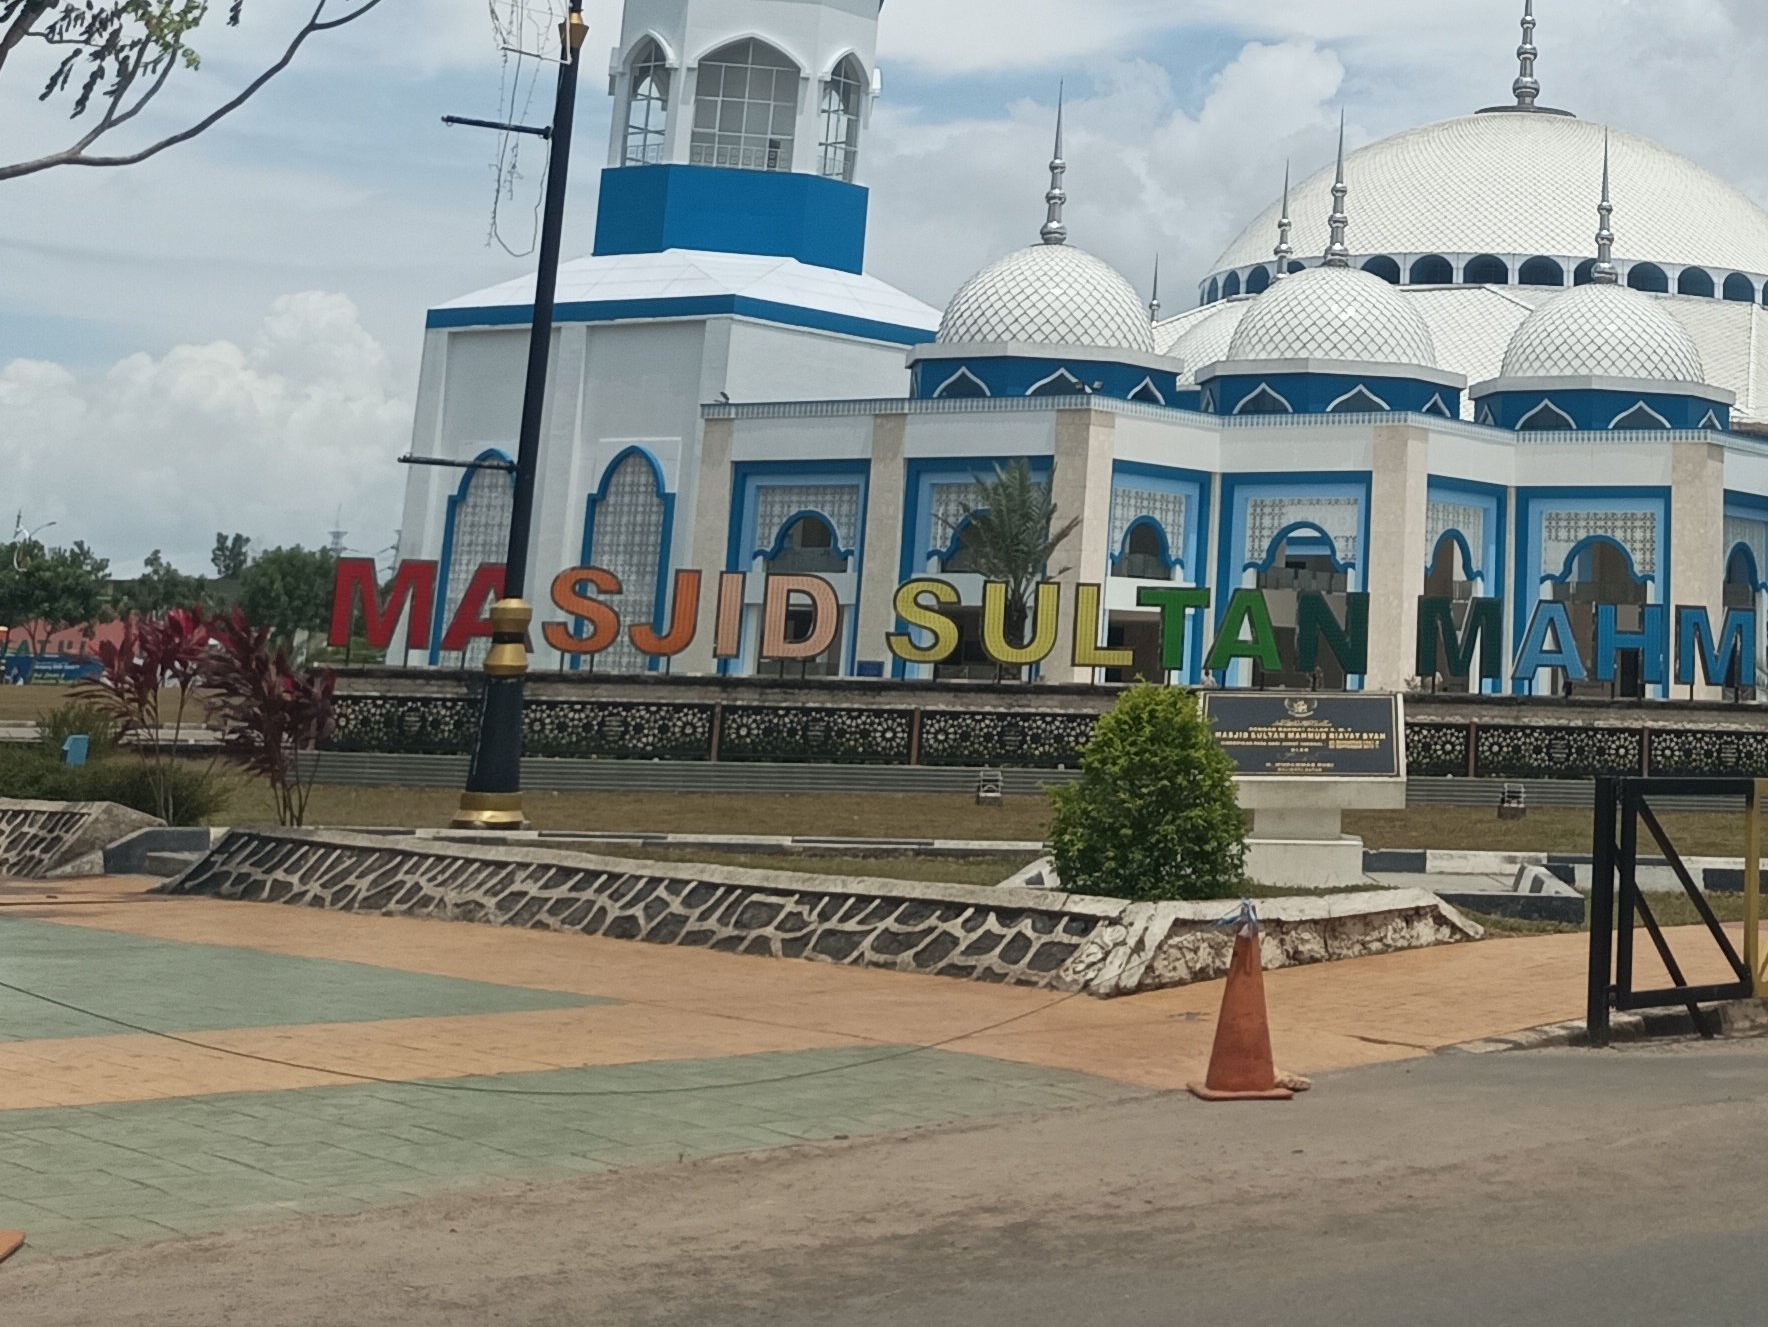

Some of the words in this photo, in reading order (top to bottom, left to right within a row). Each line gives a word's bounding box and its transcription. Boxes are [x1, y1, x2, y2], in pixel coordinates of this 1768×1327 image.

[327, 557, 840, 660] MASJID
[886, 578, 1370, 676] SULTAN
[1250, 731, 1286, 740] SULTAN
